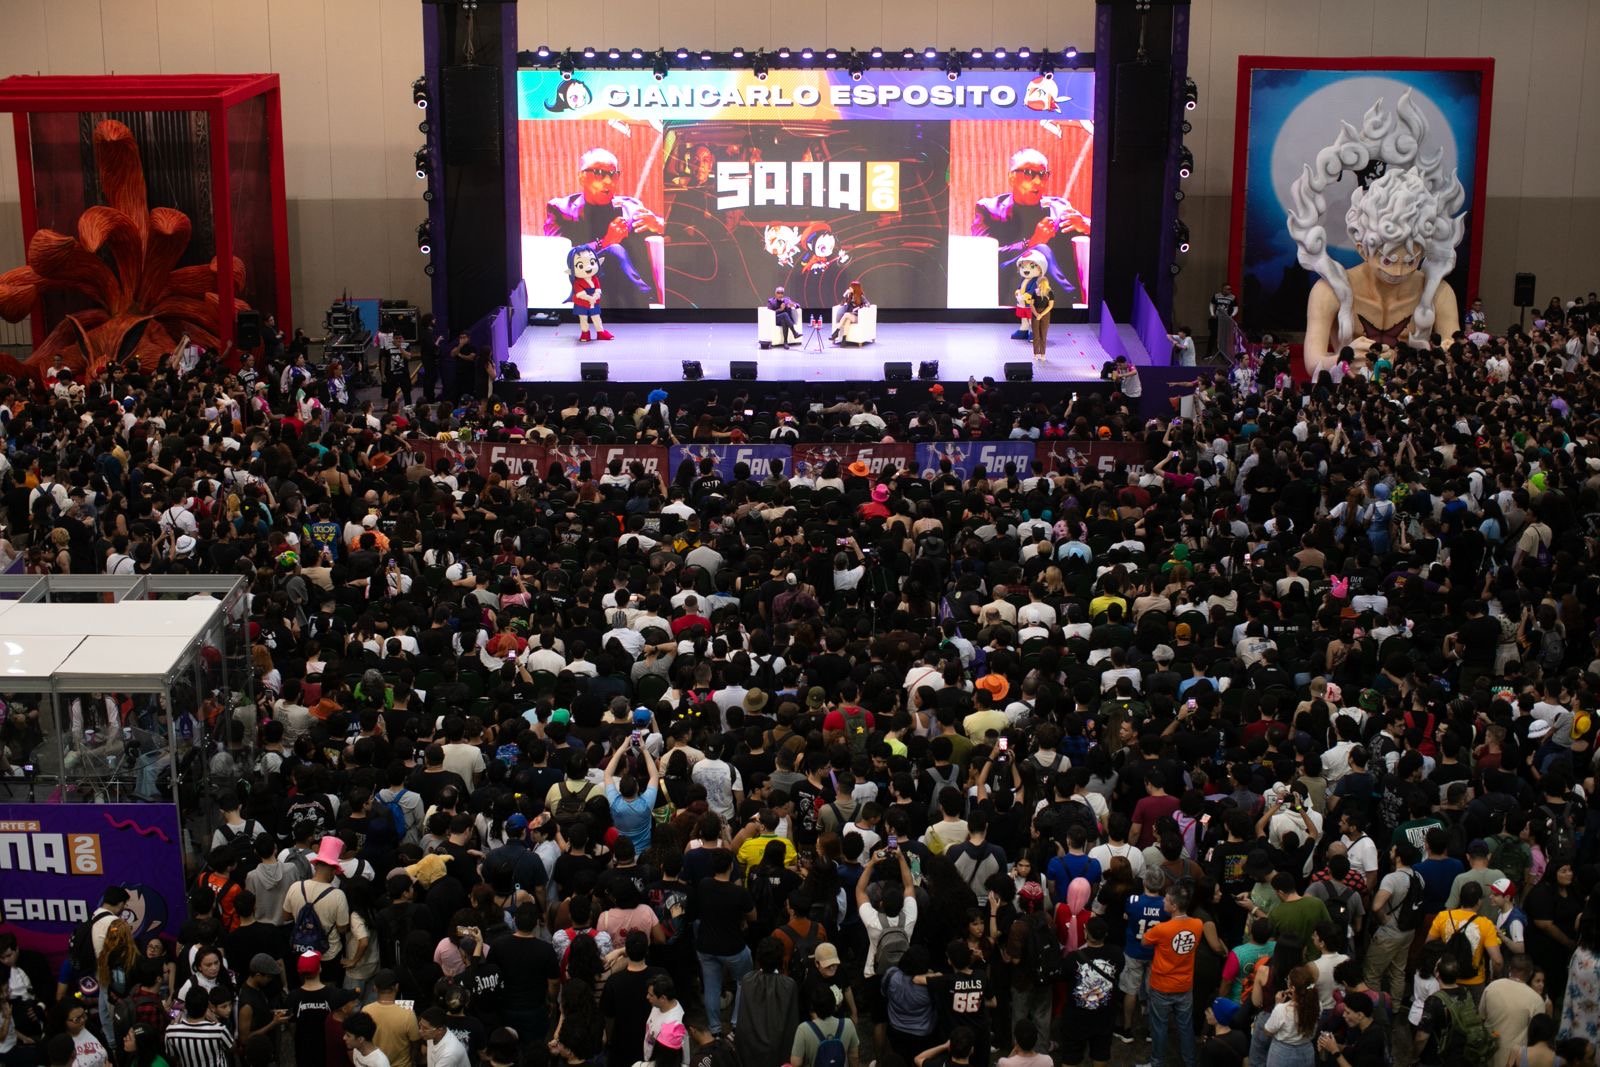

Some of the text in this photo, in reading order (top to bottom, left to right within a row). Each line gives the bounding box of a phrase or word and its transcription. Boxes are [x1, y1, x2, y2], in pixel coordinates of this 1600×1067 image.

[605, 84, 1018, 108] GIANCARLO ESPOSITO
[716, 161, 861, 211] SANA
[4, 899, 89, 923] SANA
[1143, 907, 1160, 917] LUCK
[954, 980, 982, 991] BULLS
